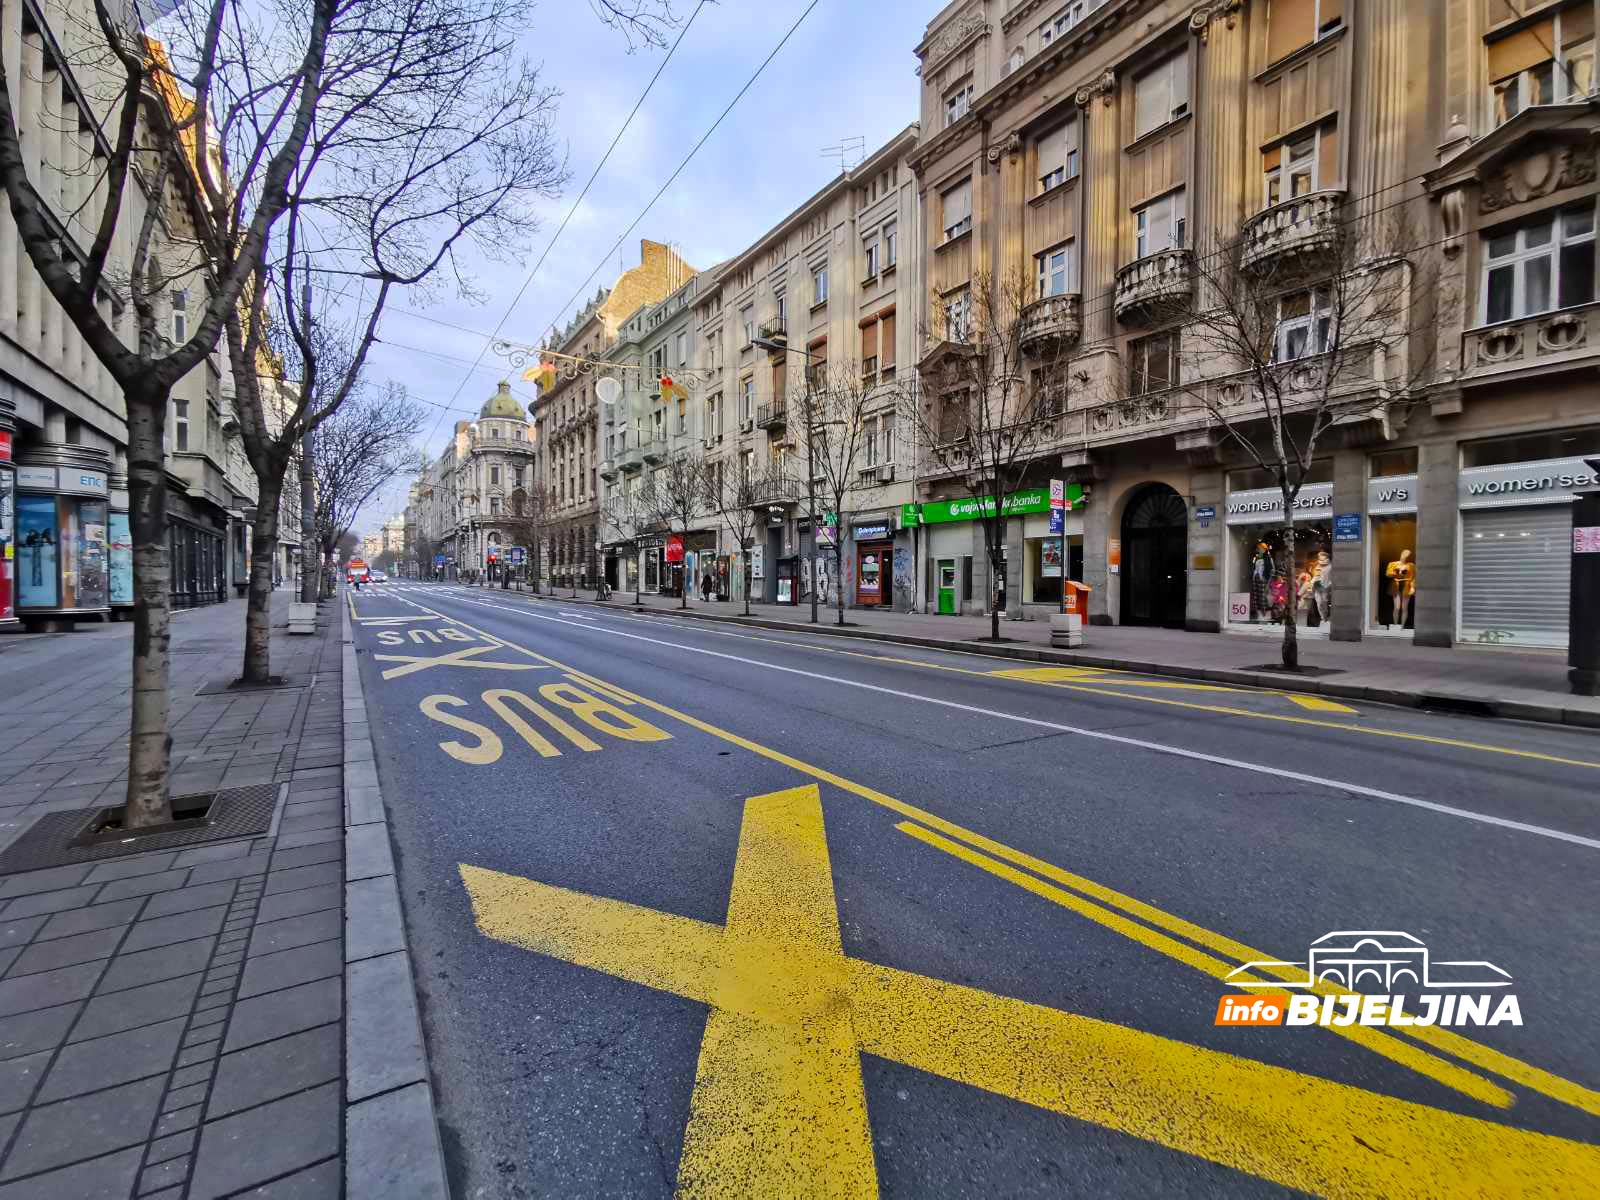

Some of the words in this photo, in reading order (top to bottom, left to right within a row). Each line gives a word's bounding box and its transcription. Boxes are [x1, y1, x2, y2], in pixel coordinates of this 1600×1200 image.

[1378, 486, 1408, 503] w's
[1231, 603, 1247, 615] 50
[376, 628, 479, 646] BUS
[419, 683, 674, 765] BUS
